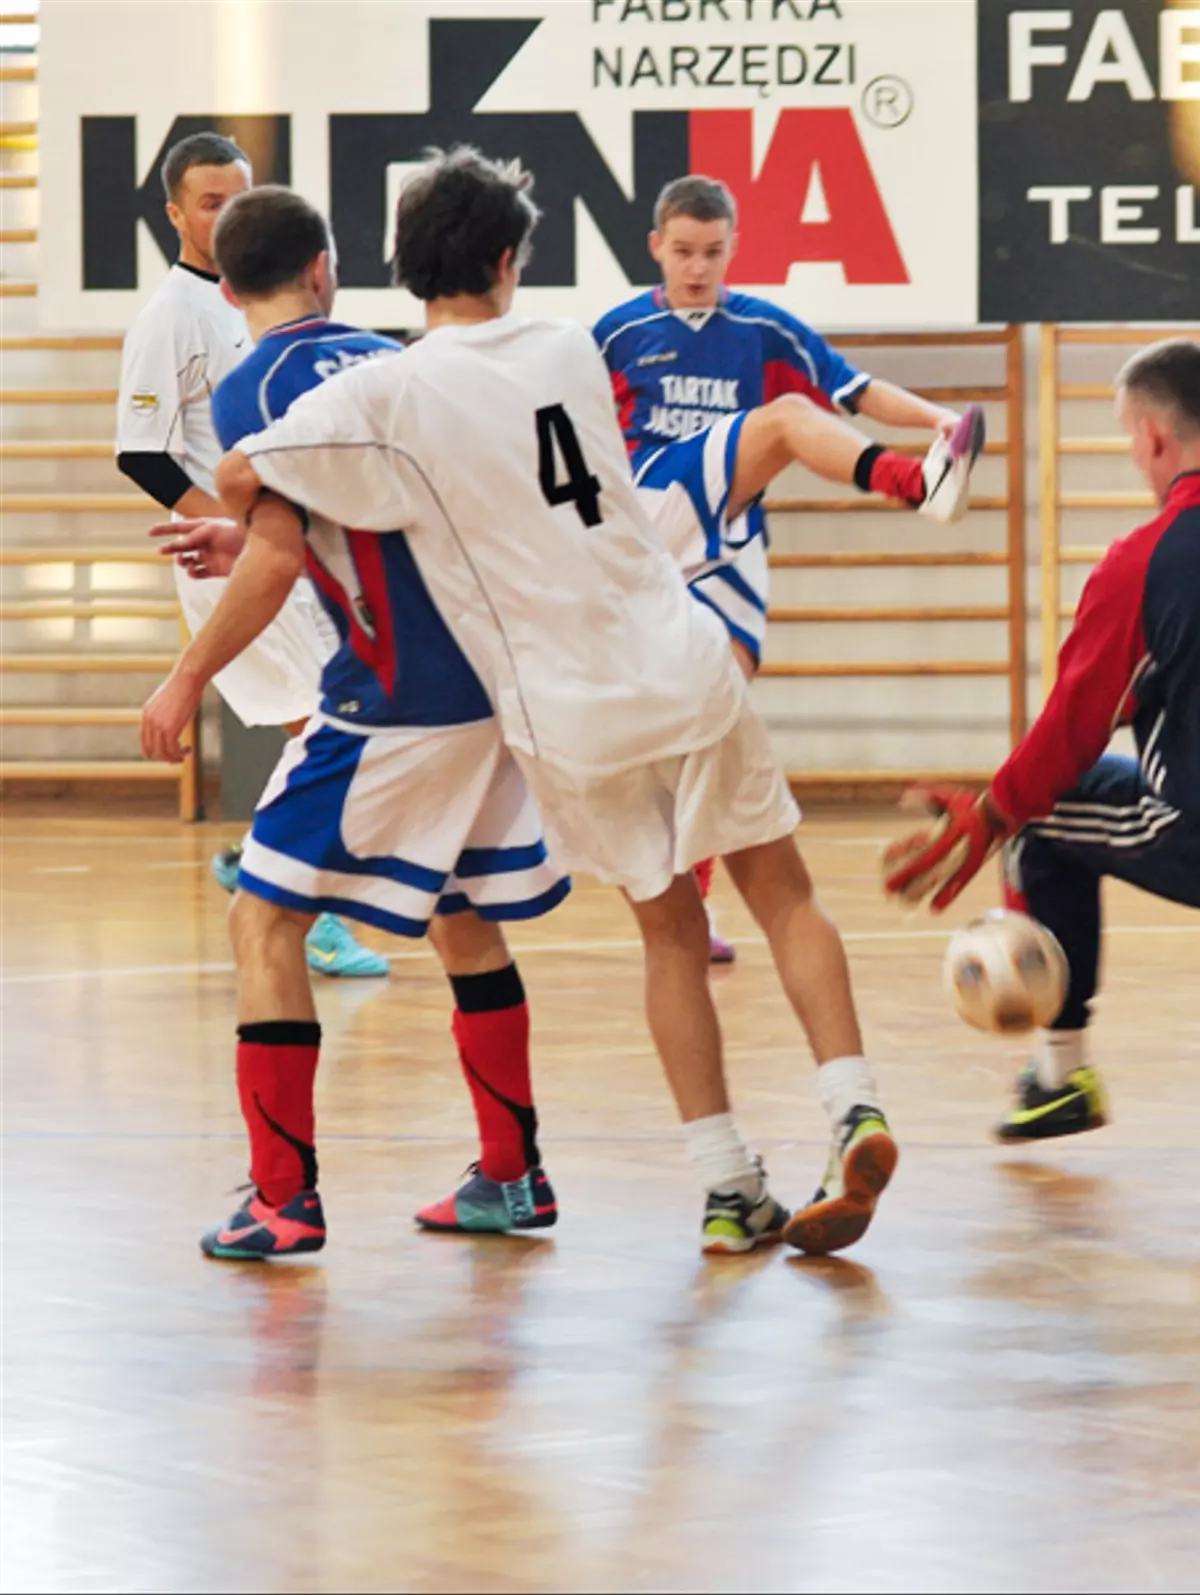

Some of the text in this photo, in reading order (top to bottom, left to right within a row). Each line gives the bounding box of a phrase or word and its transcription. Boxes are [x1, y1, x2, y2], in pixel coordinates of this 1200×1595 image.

[593, 43, 856, 99] NARZĘDZI
[659, 374, 739, 410] TARTAK
[535, 402, 604, 529] 4
